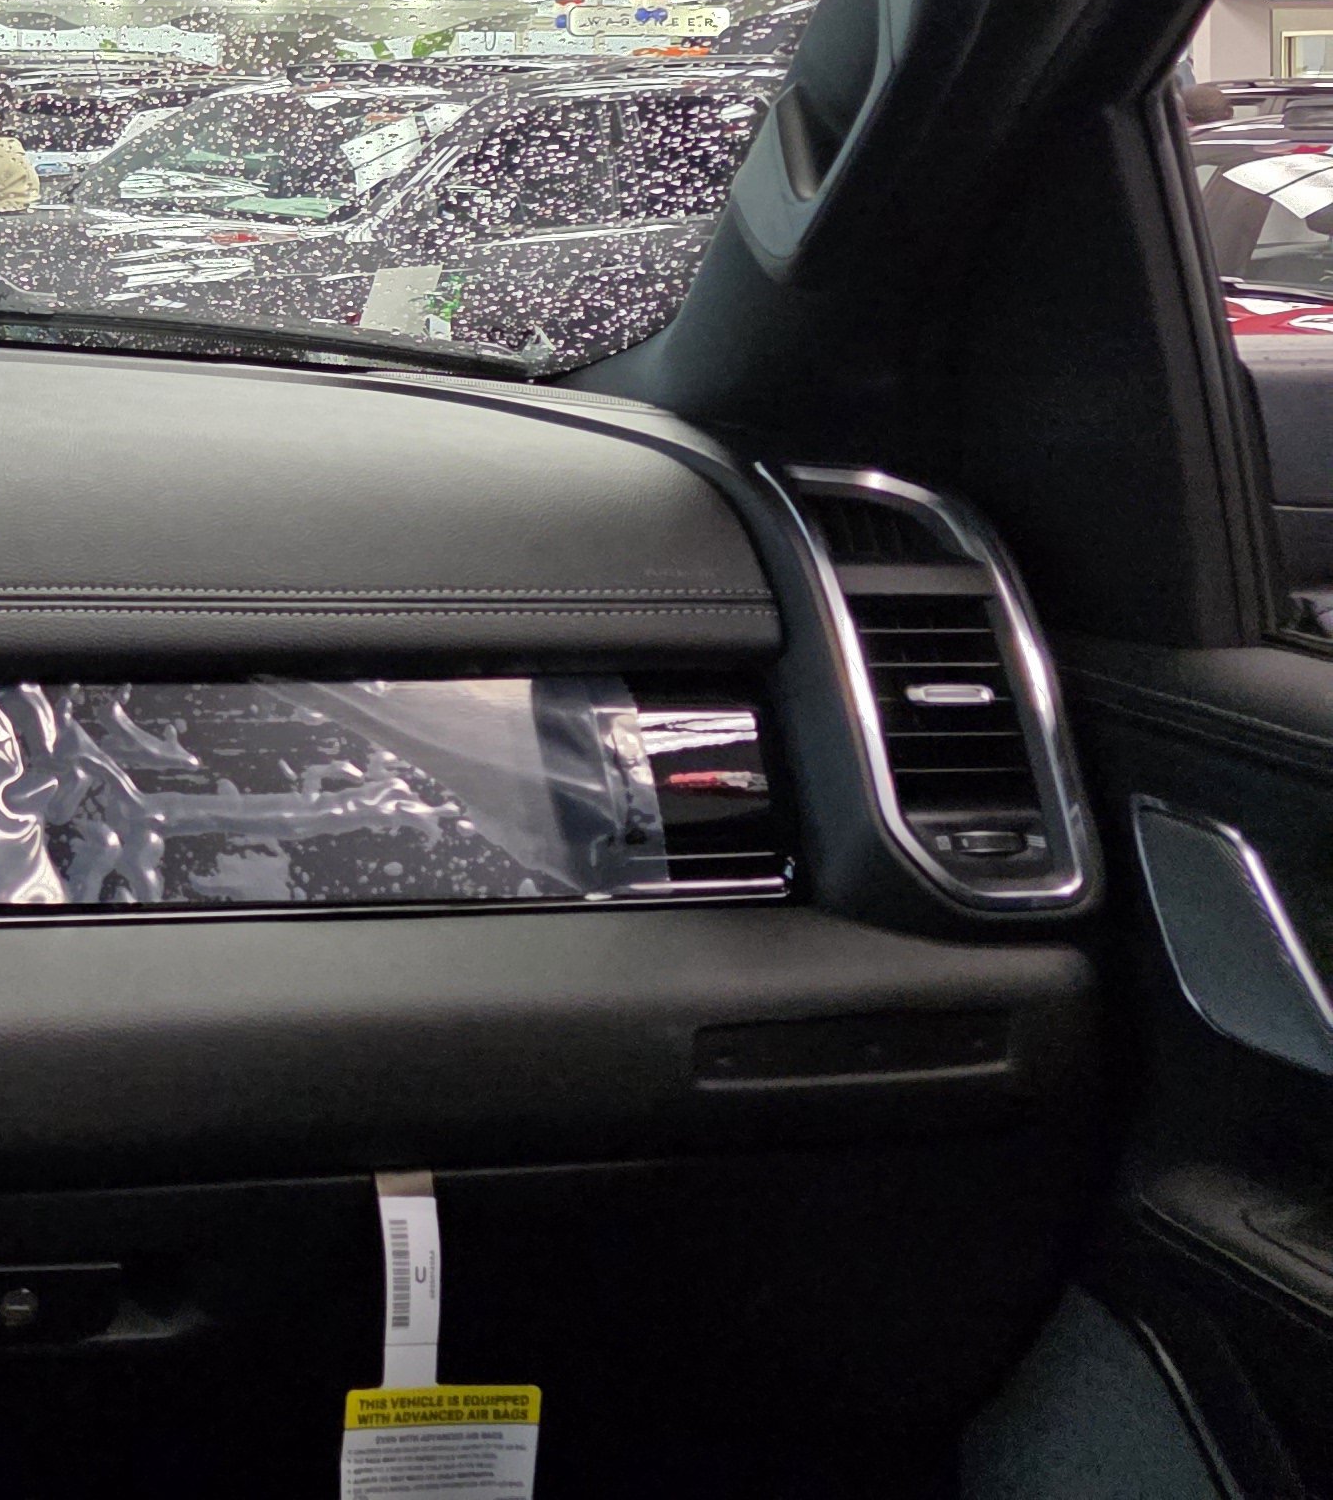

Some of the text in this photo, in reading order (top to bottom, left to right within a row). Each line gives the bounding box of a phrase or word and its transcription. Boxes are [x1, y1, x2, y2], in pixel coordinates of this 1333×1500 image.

[587, 16, 714, 27] WAGNEER
[359, 1394, 530, 1411] THIS VEHICLE IS EQUIPPED
[357, 1408, 529, 1425] WITH ADVANCED AIR BAGS
